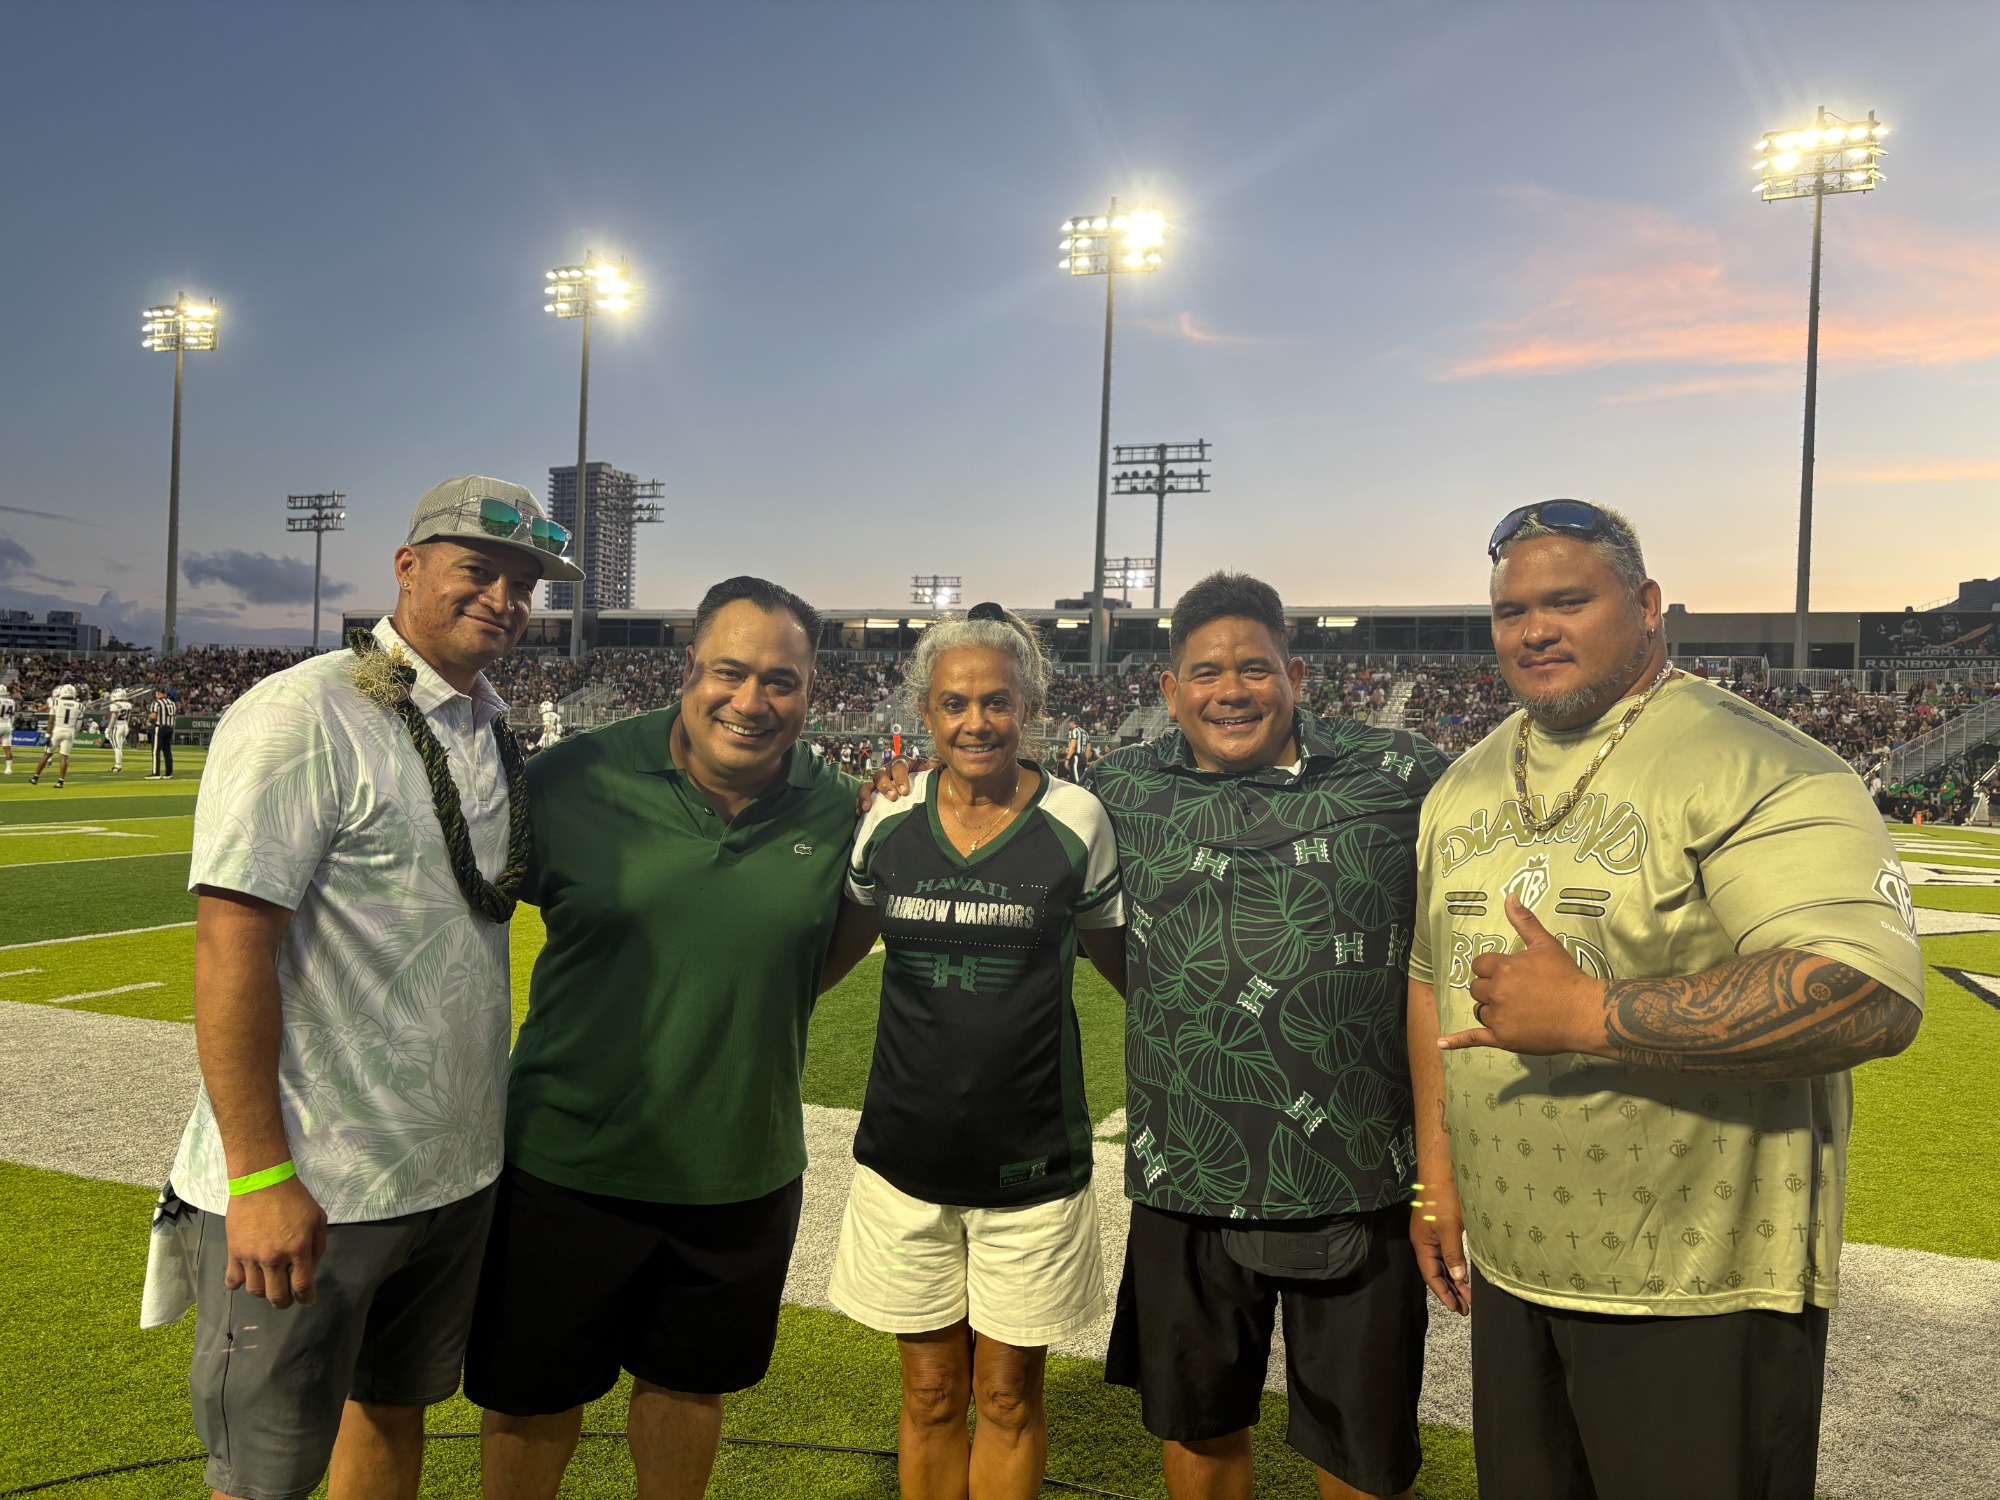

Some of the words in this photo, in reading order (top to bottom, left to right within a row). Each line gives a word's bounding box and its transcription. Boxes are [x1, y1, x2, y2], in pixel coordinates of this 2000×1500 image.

[1864, 660, 1950, 669] RAINBOW
[64, 709, 70, 724] 1
[885, 894, 951, 922] RAINBOW
[954, 901, 1035, 929] WARRIORS
